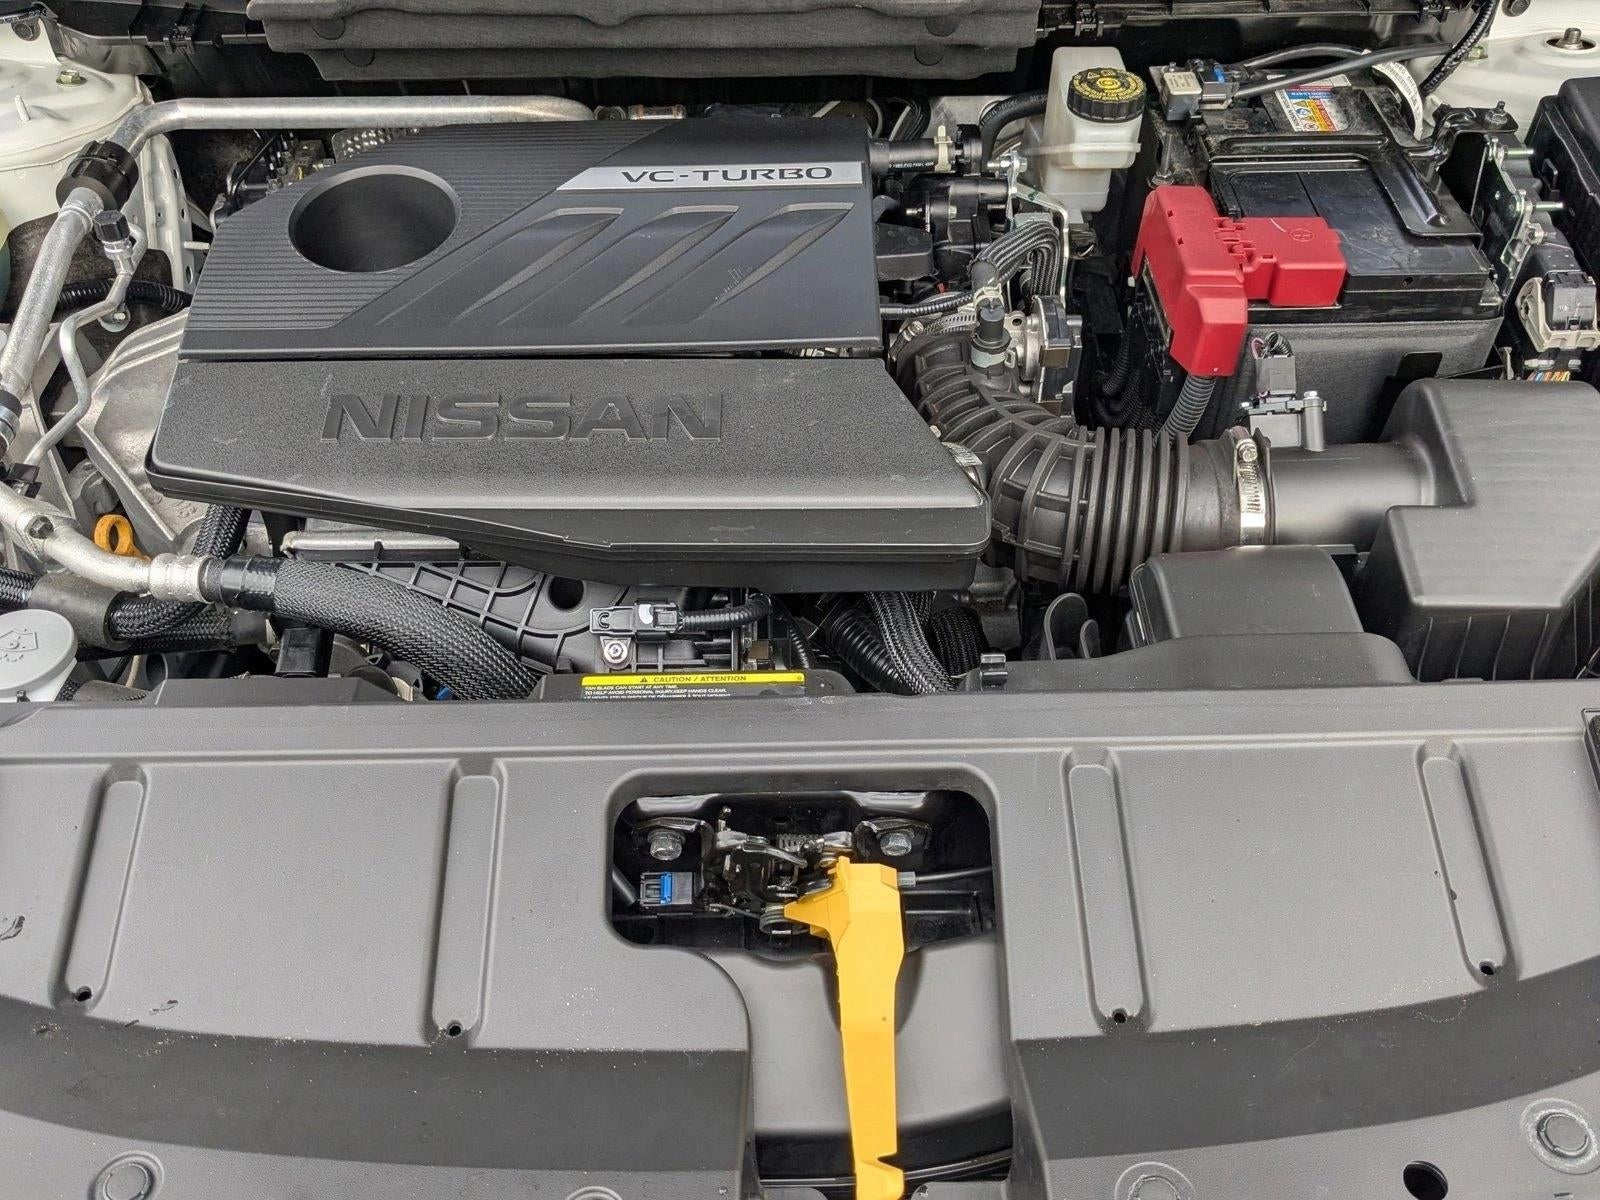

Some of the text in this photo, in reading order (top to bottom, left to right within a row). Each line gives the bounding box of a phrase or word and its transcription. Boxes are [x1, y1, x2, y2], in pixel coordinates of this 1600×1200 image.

[621, 166, 833, 183] VC-TURBO
[320, 393, 723, 442] NISSAN
[700, 674, 747, 682] ATTENTION
